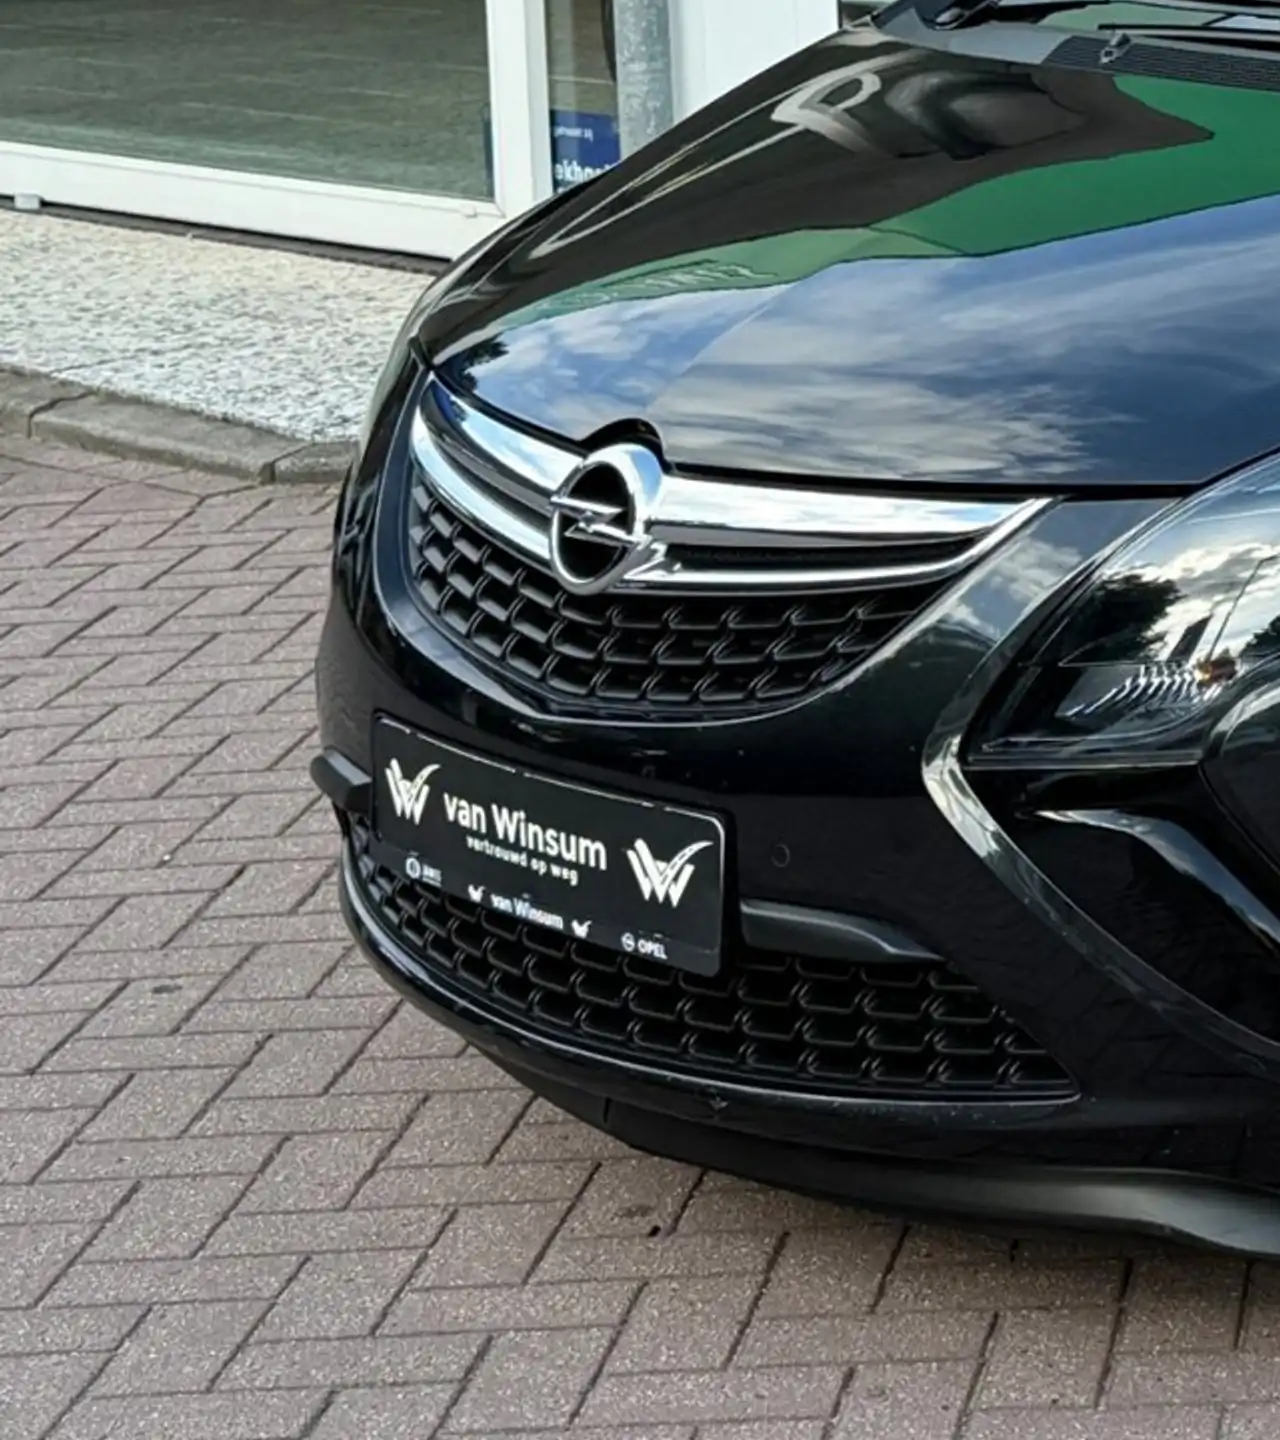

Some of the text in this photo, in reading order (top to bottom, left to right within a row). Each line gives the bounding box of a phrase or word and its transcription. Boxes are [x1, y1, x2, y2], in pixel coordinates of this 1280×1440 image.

[443, 791, 608, 872] van Winsum
[466, 835, 580, 888] vertrouwd op weg
[490, 893, 565, 931] van Winsum
[637, 938, 668, 961] OPEL
